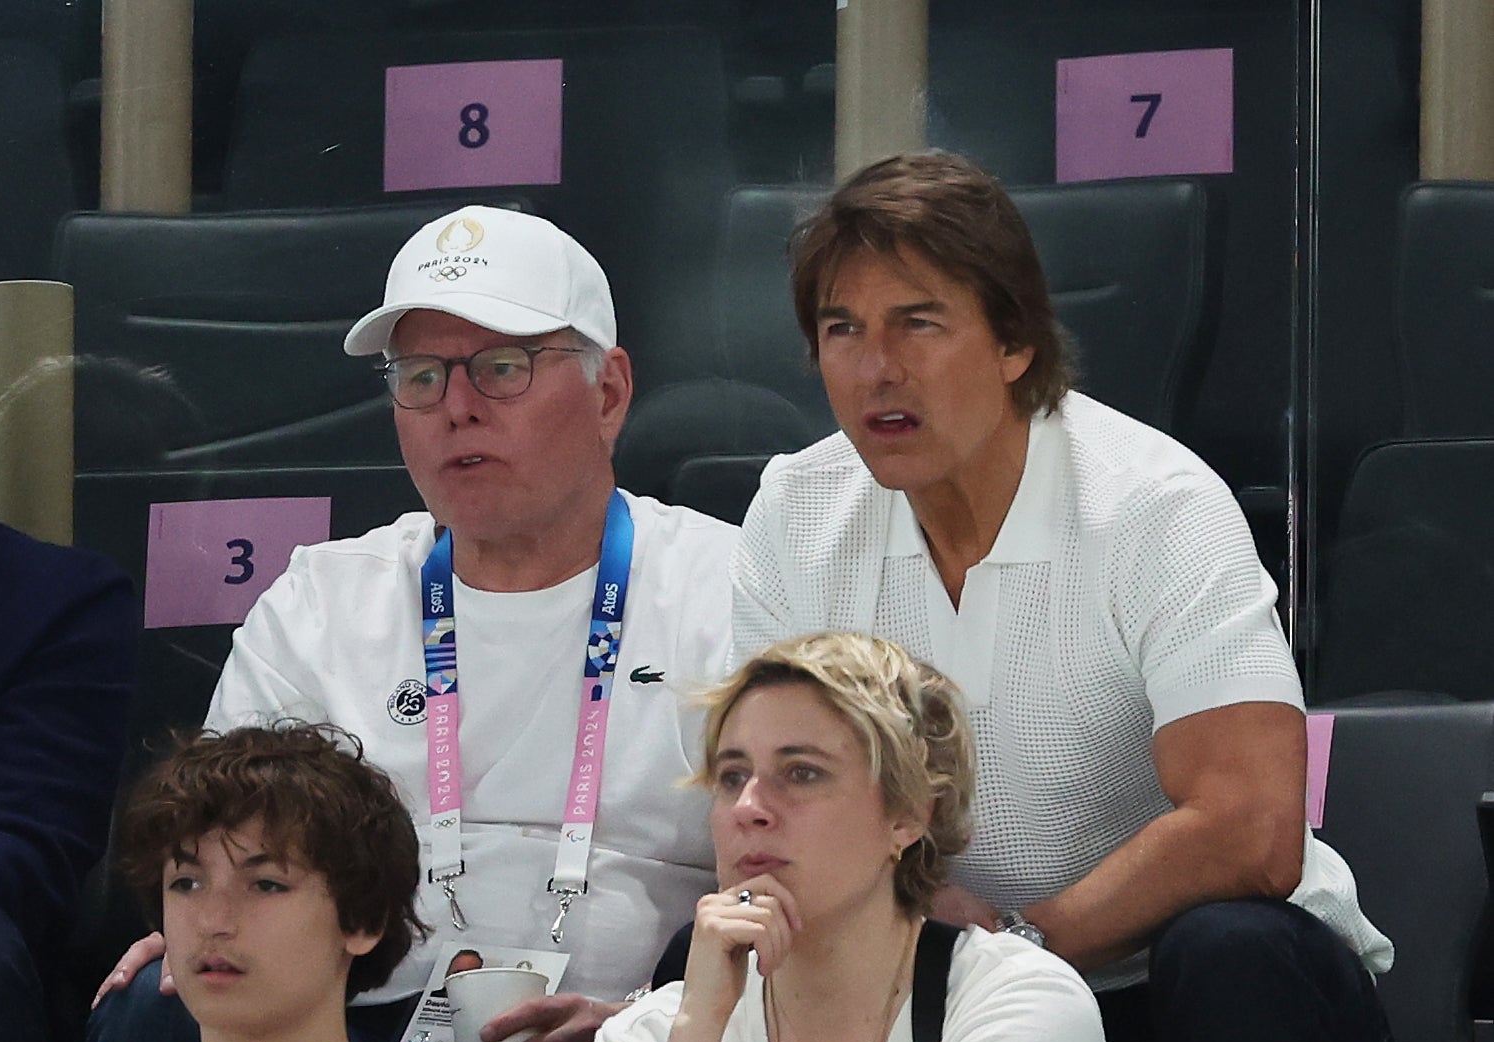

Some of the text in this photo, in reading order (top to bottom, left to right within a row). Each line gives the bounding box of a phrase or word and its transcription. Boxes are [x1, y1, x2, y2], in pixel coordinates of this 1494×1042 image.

[458, 103, 490, 149] 8
[1129, 94, 1162, 139] 7
[417, 255, 488, 272] PARIS 2024
[224, 538, 255, 585] 3
[435, 703, 451, 806] PARIS 2024
[572, 709, 601, 816] PARIS 2024
